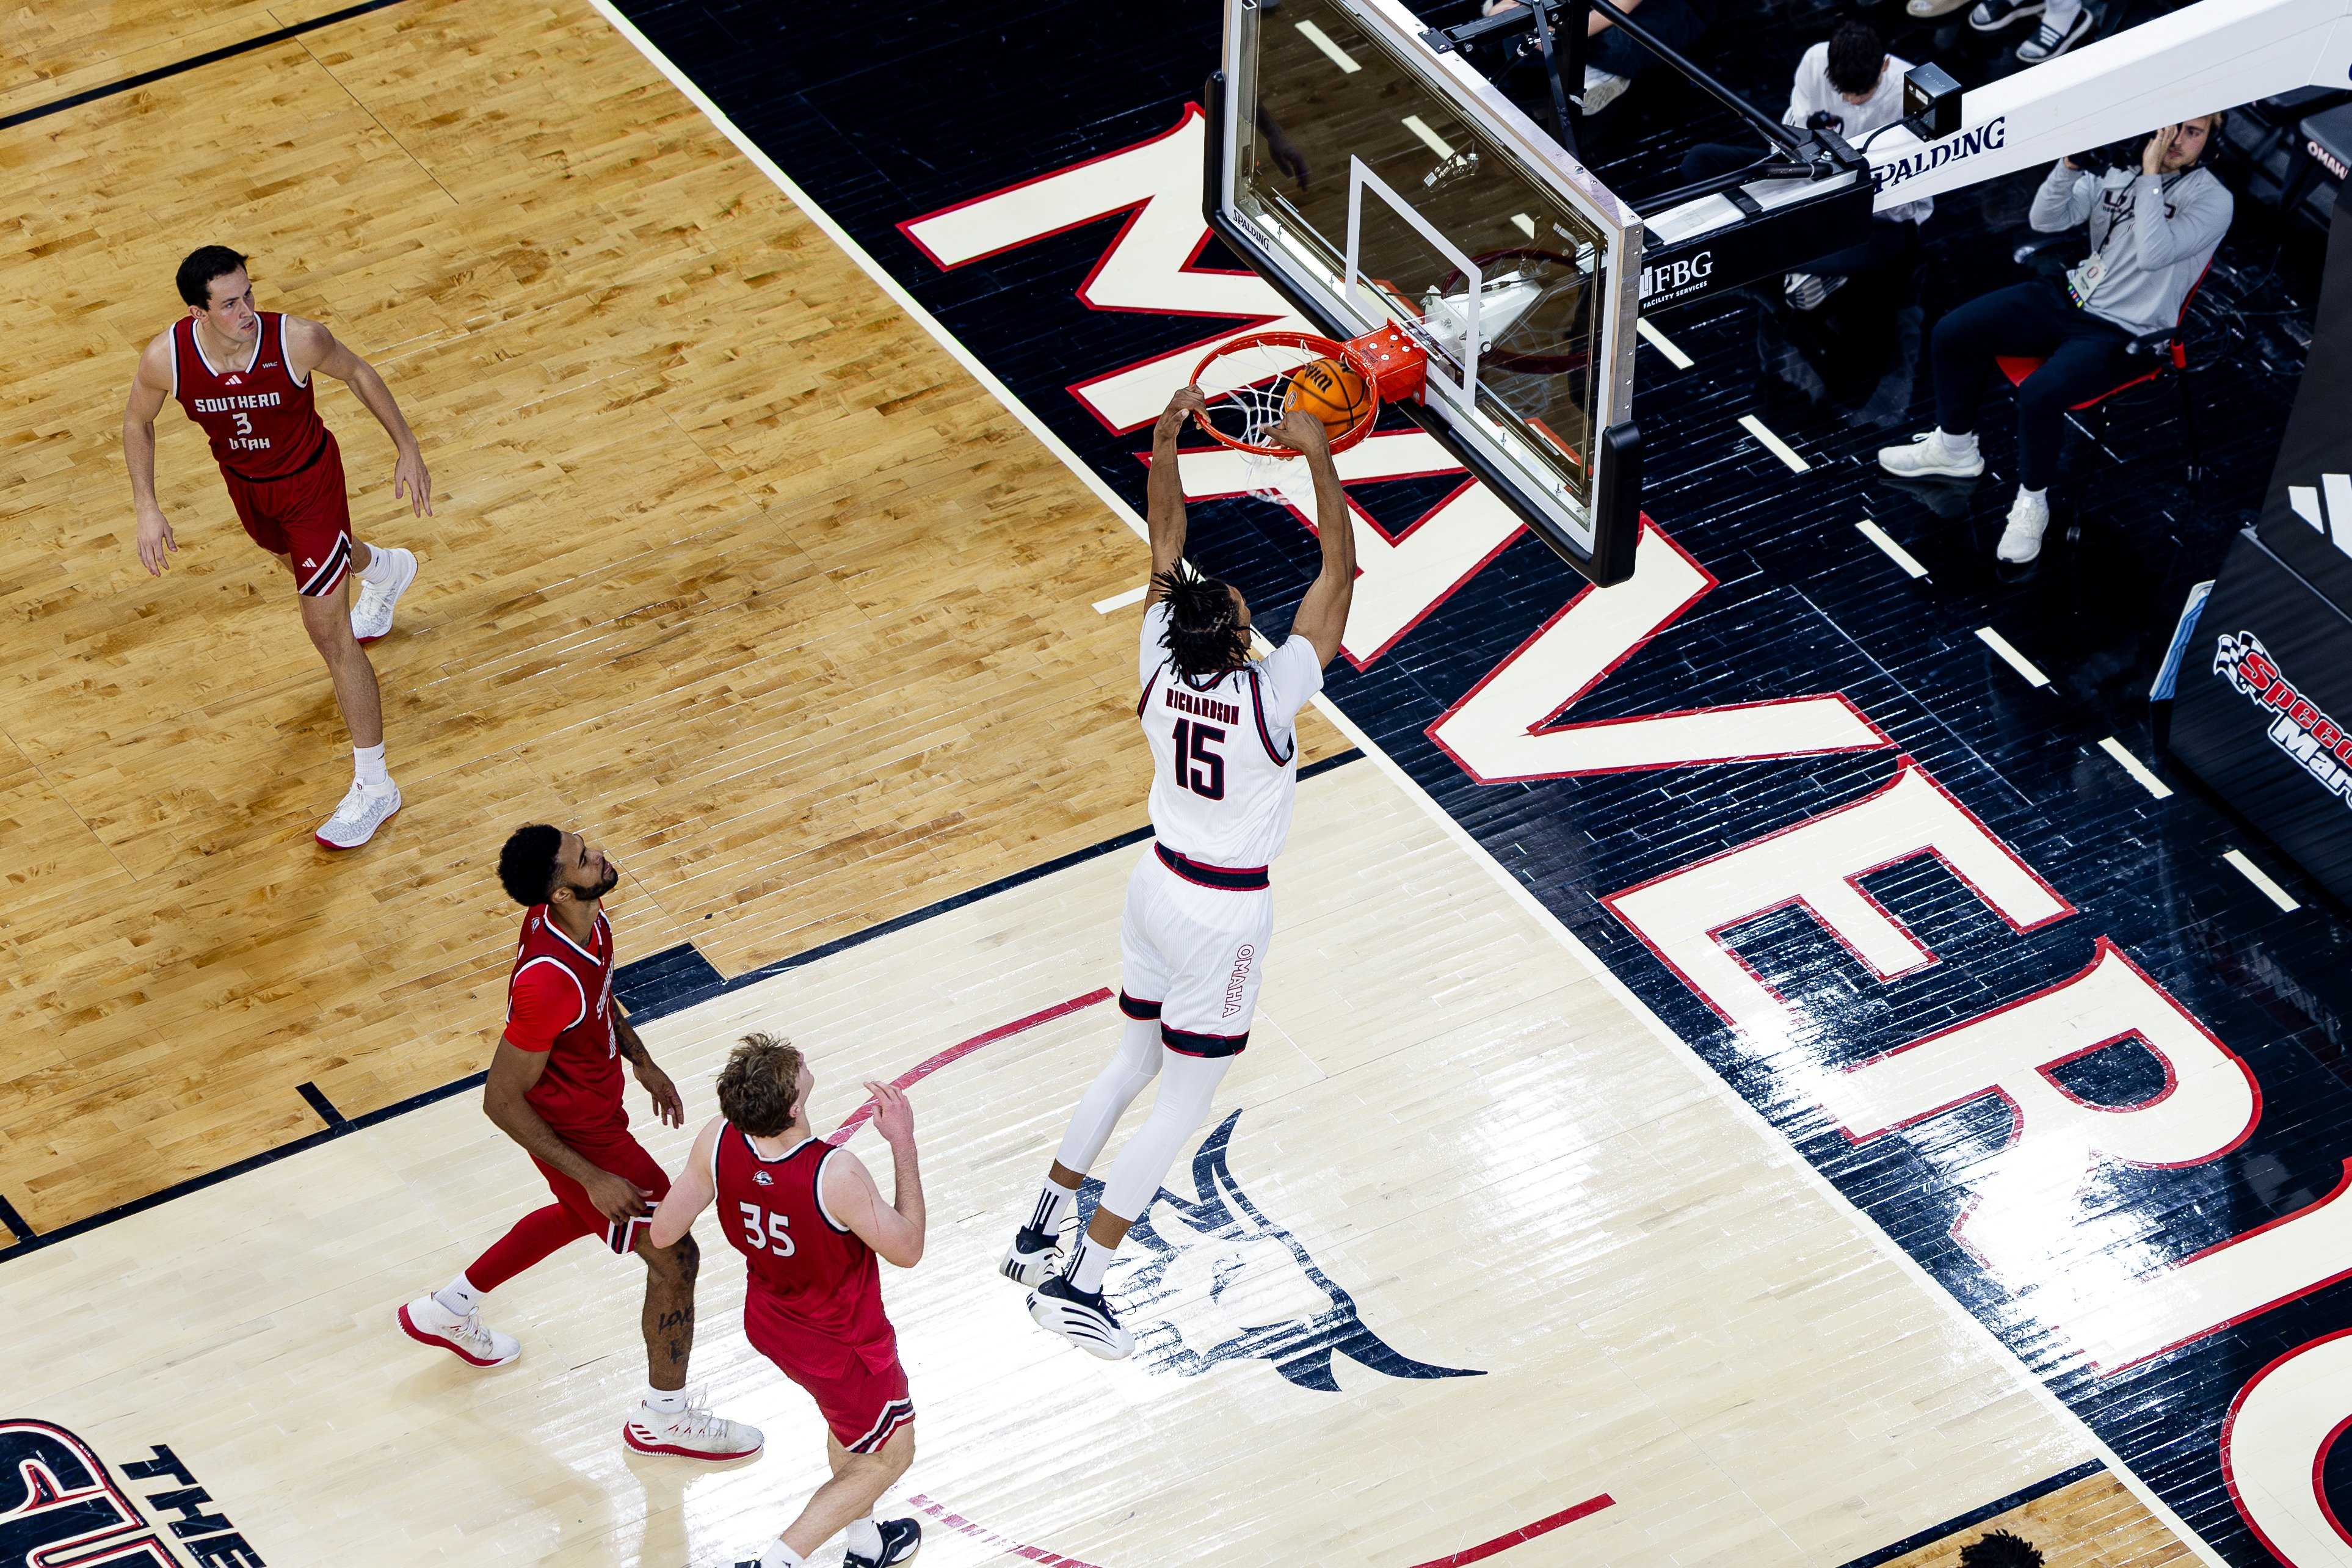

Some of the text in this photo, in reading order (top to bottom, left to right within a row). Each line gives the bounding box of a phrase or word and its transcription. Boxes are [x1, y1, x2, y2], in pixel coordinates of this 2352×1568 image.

[1870, 116, 2005, 195] PALDING
[1233, 209, 1270, 253] SPALDING
[1643, 280, 1707, 309] FACILITY SERVICES
[1654, 251, 1713, 294] FBG
[194, 392, 280, 412] SOUTHERN
[232, 412, 252, 435] 3
[228, 437, 270, 451] UTAH
[1166, 688, 1239, 725] RICHARDSON
[1172, 717, 1225, 800] 15
[2271, 716, 2352, 795] Mar
[1222, 943, 1254, 1018] OMAHA
[739, 1201, 795, 1258] 35
[118, 1444, 267, 1568] THE
